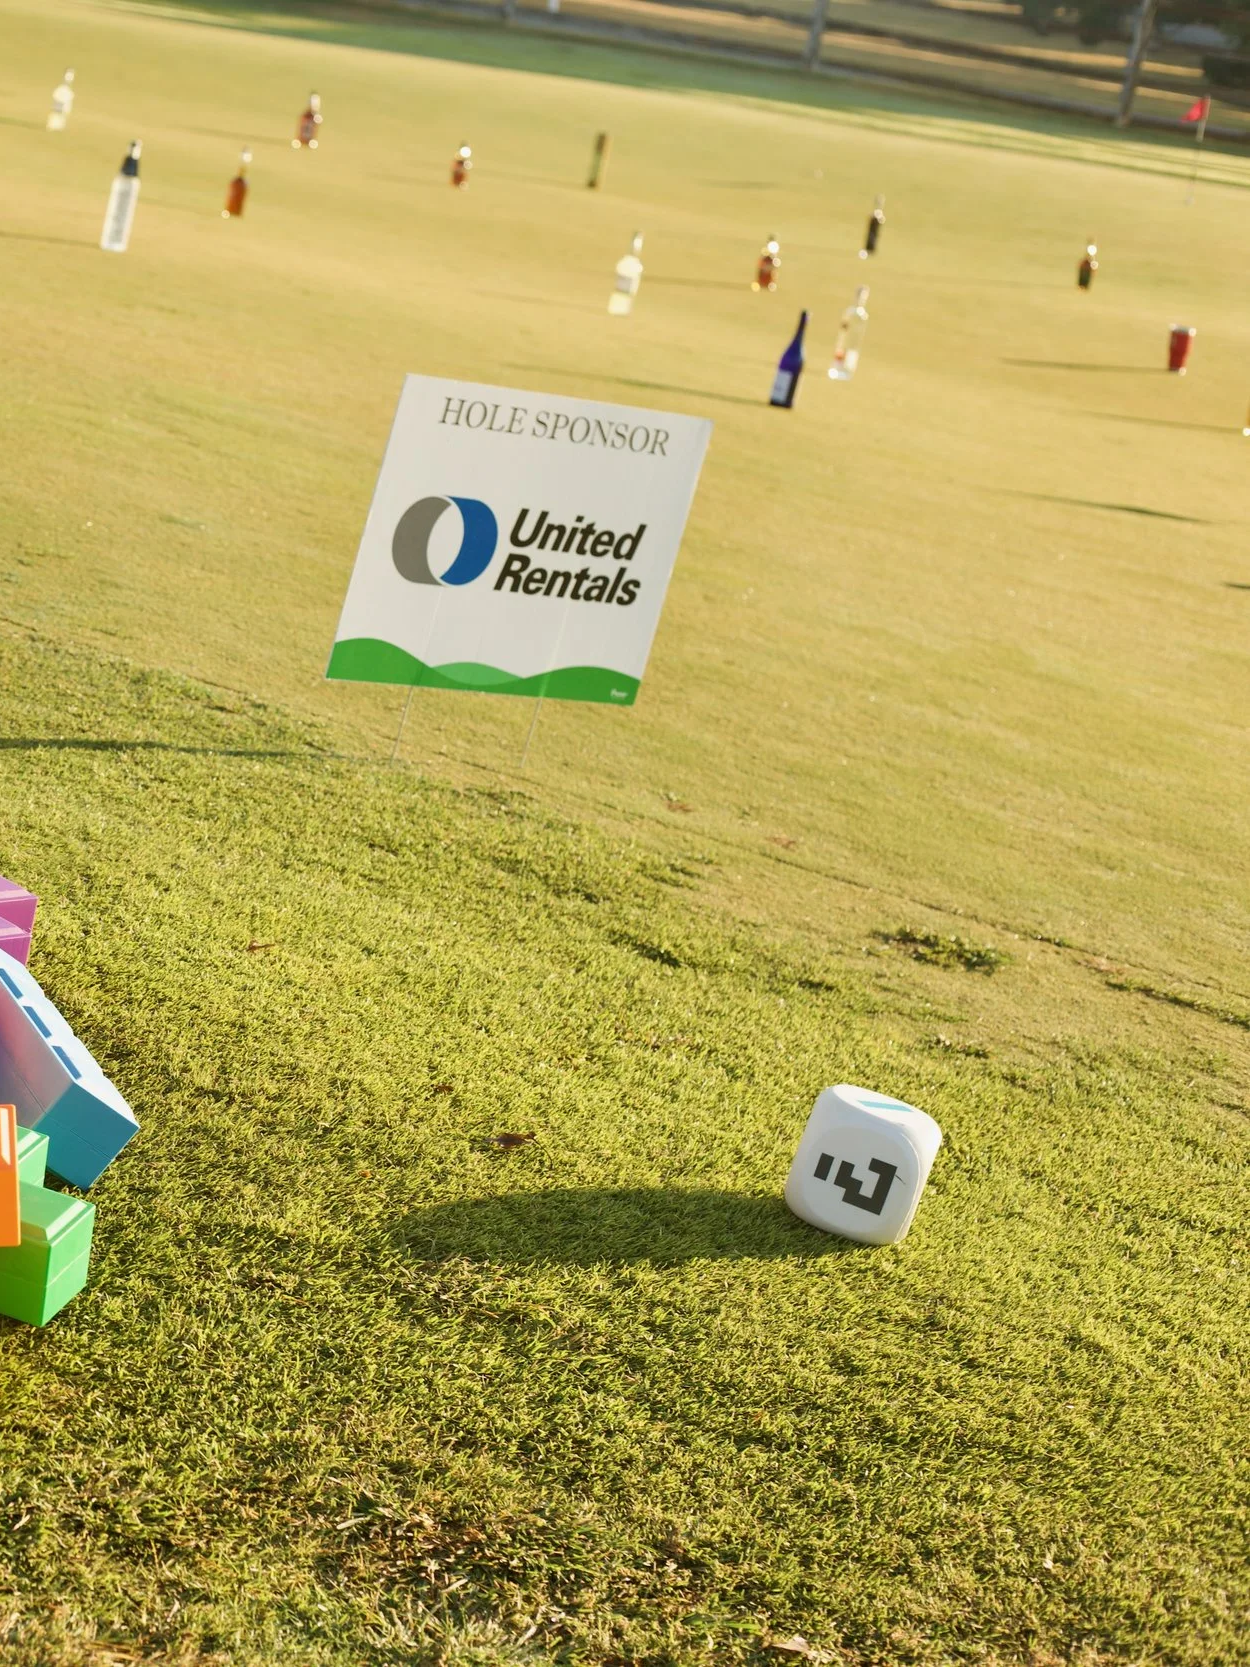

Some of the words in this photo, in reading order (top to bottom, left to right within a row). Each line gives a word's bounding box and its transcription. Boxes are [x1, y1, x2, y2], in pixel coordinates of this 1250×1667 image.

[438, 397, 528, 435] HOLE
[531, 410, 670, 457] SPONSOR
[509, 508, 647, 561] United
[493, 553, 641, 606] Rentals
